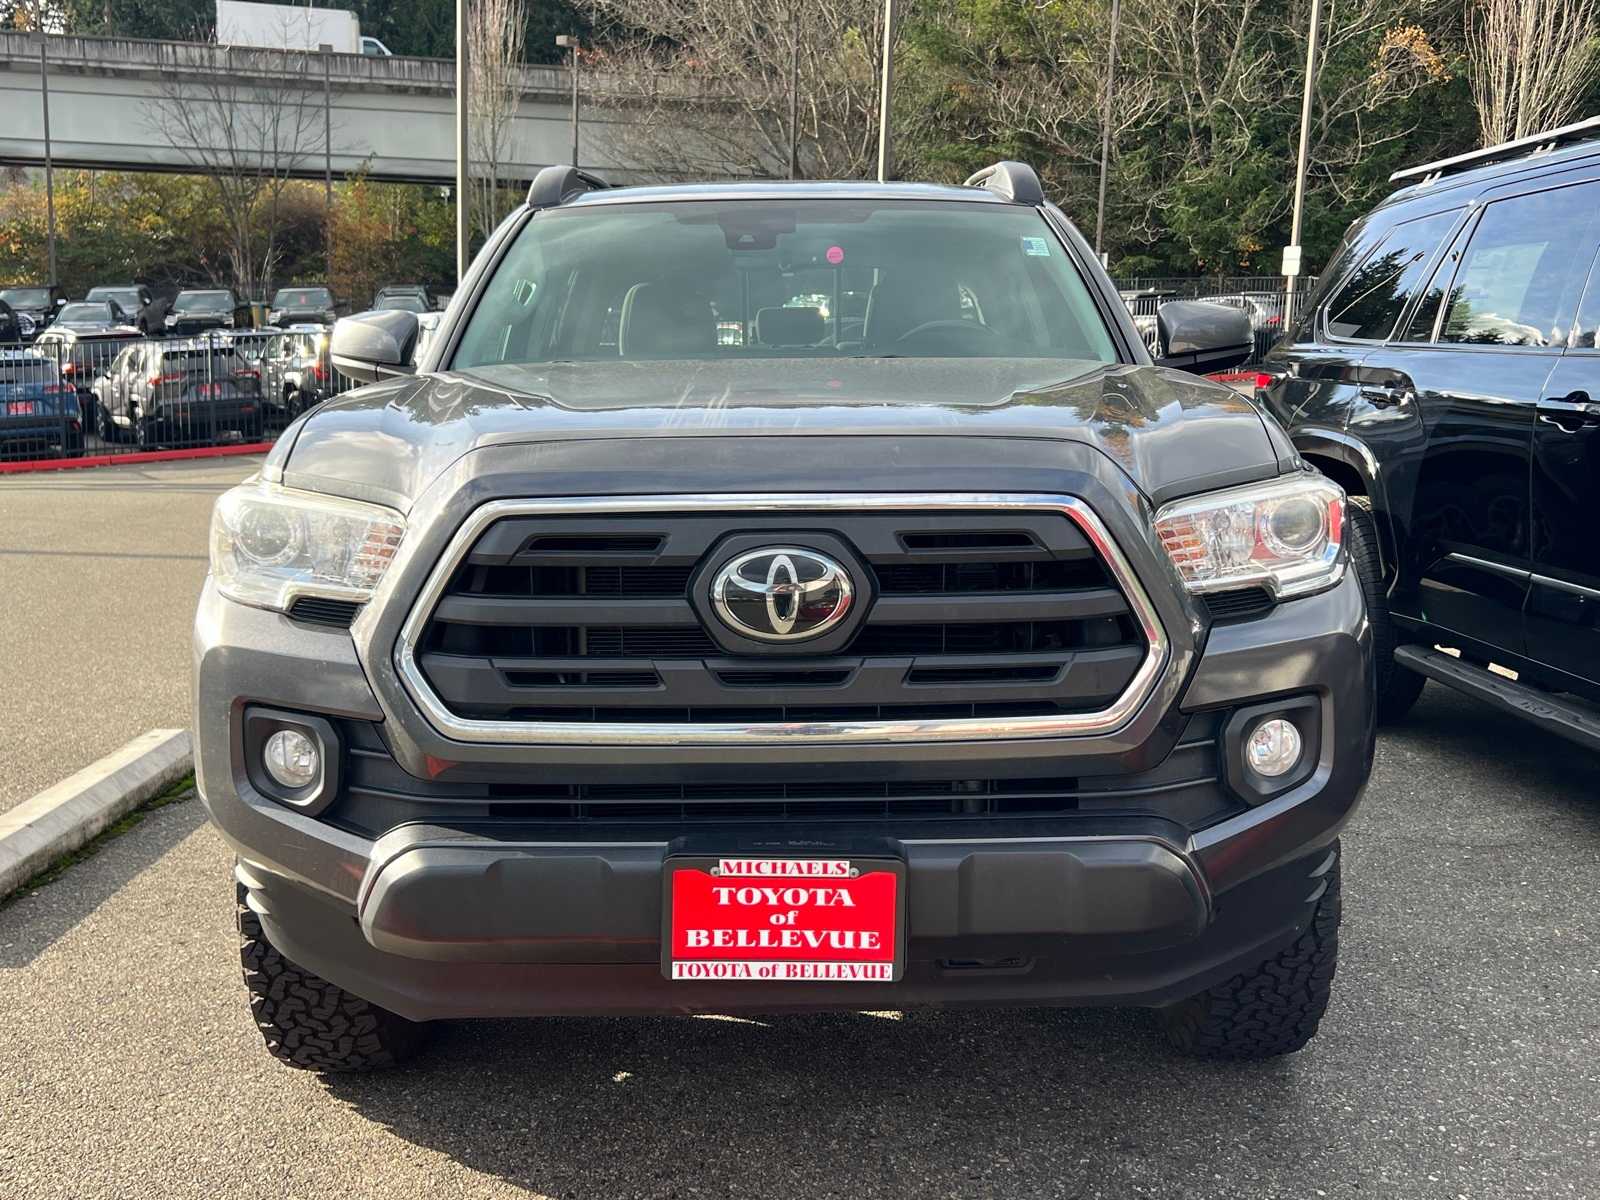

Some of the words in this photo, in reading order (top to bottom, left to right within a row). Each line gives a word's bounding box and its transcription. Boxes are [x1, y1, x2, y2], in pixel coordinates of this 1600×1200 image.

[723, 861, 848, 875] MICHAELS
[712, 887, 856, 907] TOYOTA
[769, 910, 799, 925] of
[685, 929, 881, 950] BELLEVUE
[674, 963, 752, 978] TOYOTA
[758, 963, 780, 978] of
[785, 963, 891, 979] BELLEVUE
